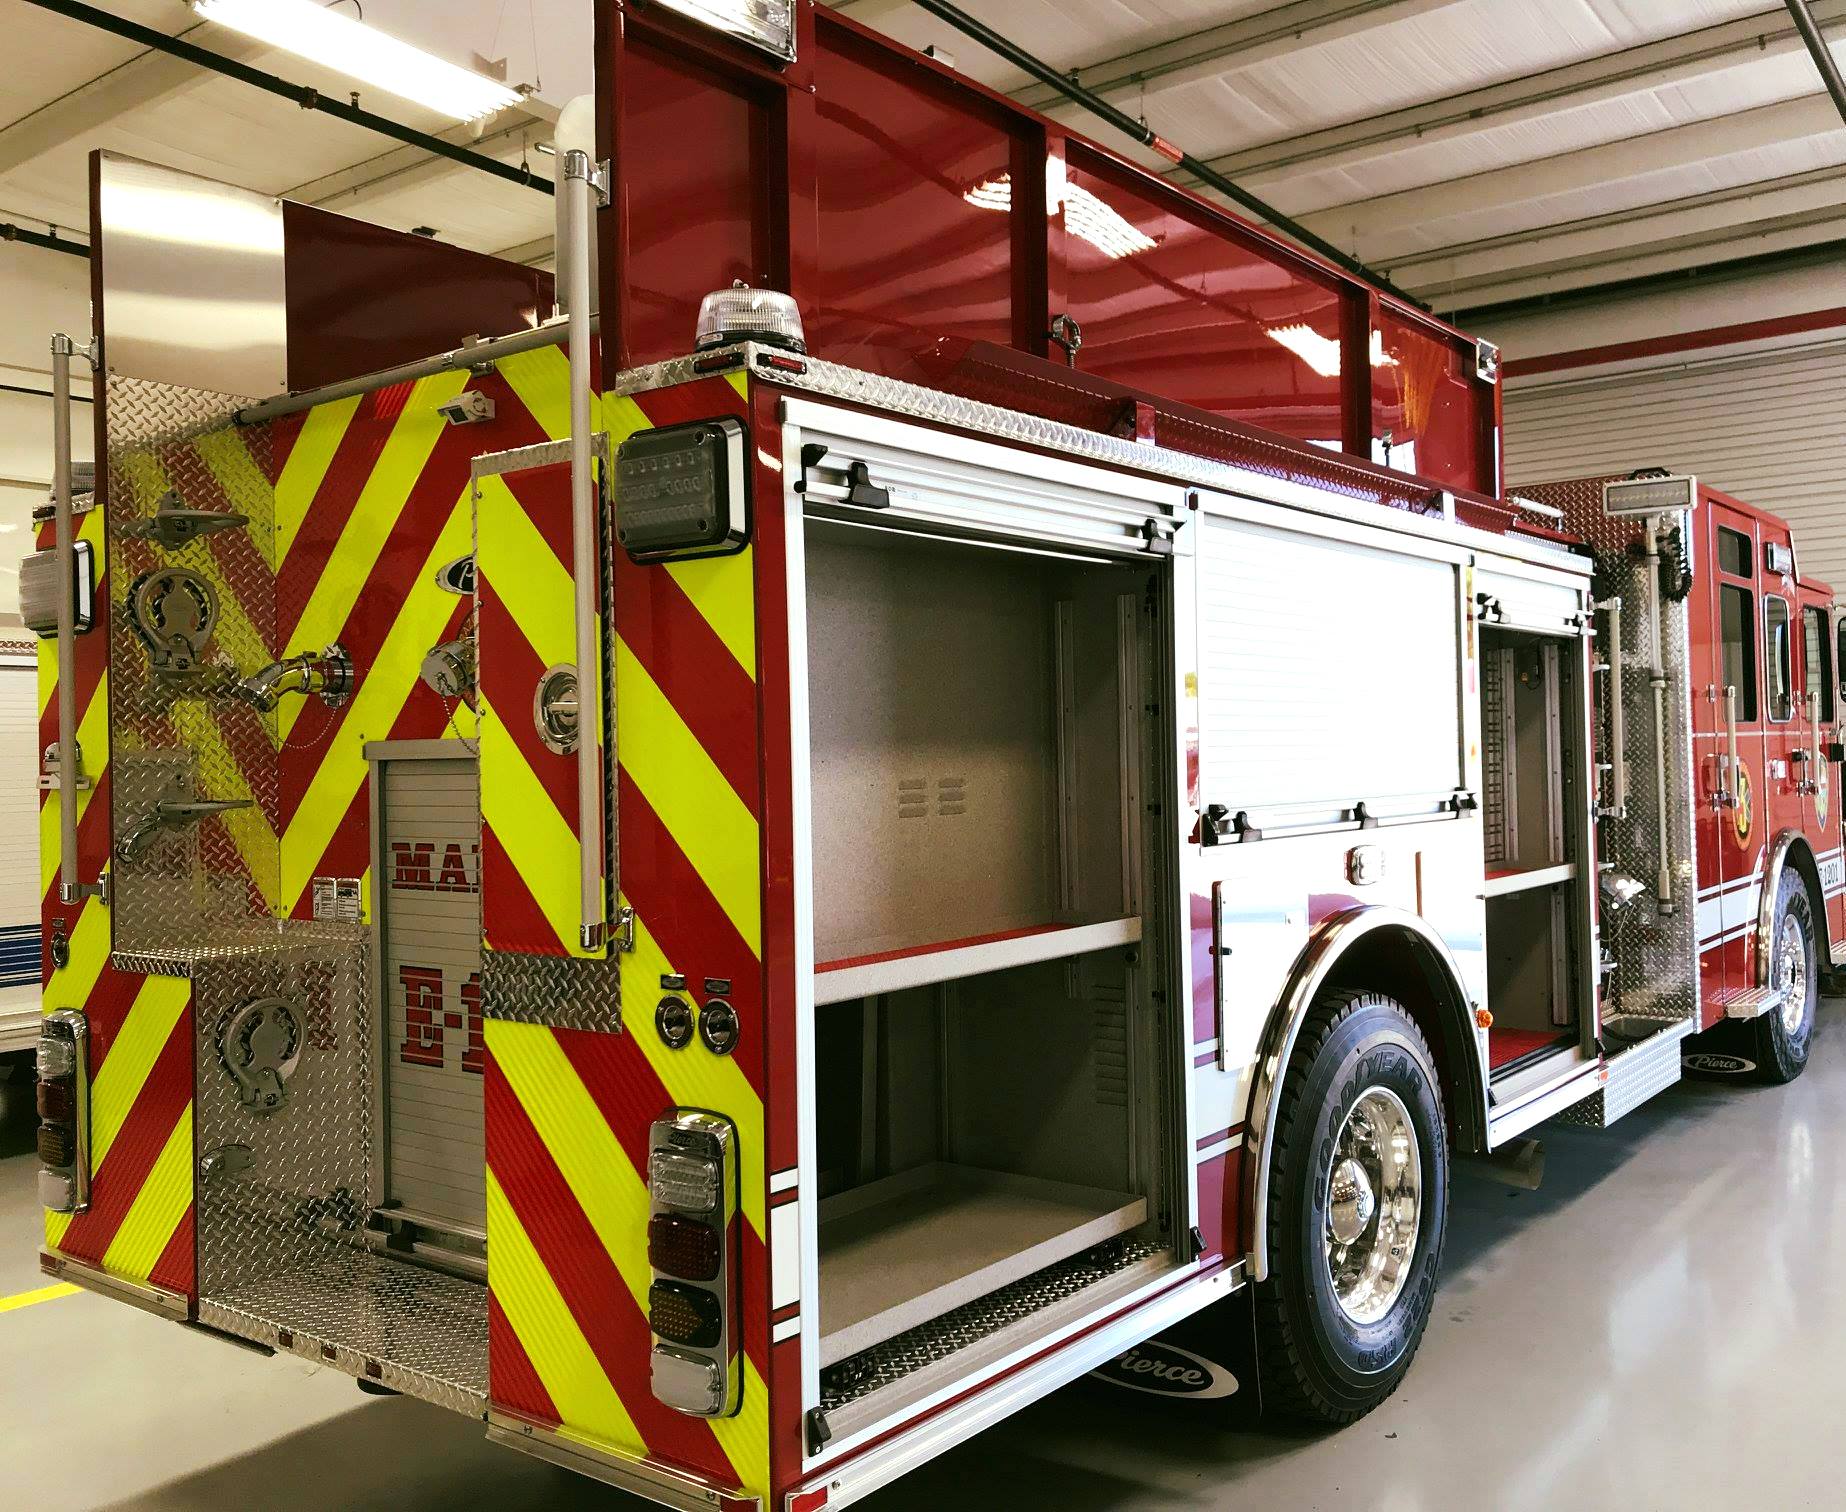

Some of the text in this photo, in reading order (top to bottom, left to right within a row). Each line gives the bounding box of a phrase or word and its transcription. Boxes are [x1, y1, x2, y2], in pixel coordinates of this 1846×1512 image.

[392, 842, 479, 893] MA
[1695, 1056, 1738, 1069] Pierce
[1118, 1350, 1205, 1385] ierce
